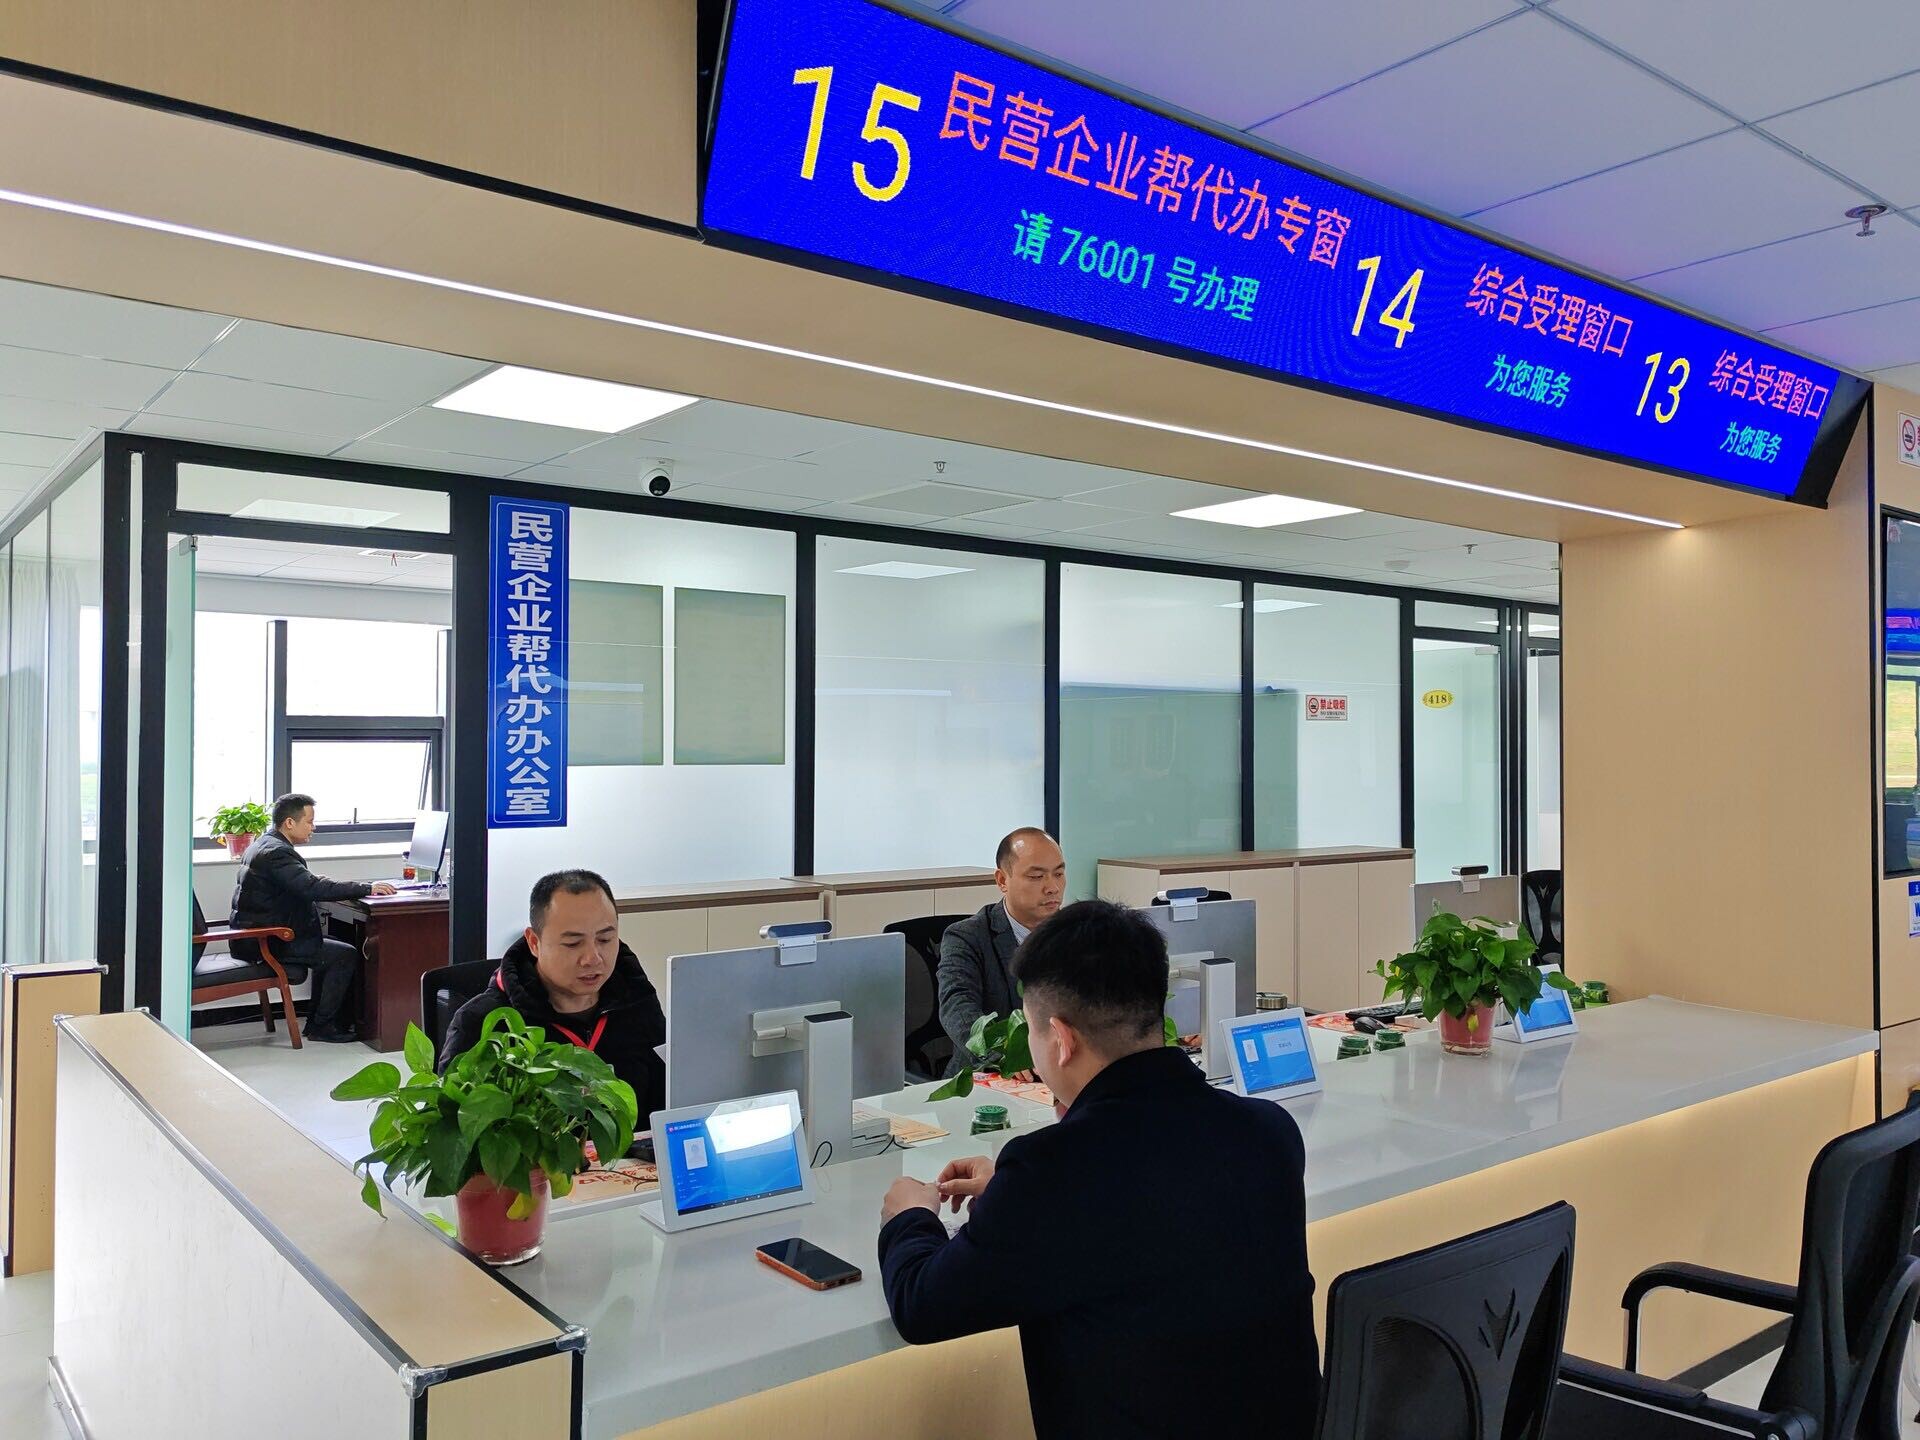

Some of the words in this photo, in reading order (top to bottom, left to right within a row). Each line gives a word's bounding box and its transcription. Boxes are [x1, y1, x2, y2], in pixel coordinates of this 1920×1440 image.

[792, 65, 921, 201] 15
[939, 71, 1352, 269] 民营企业帮代办专窗
[1013, 209, 1051, 264] 请
[1059, 227, 1155, 289] 76001
[1165, 256, 1261, 321] 号办理
[1351, 255, 1425, 349] 14
[1464, 262, 1634, 358] 综合受理窗口
[1485, 353, 1573, 409] 为您服务
[1636, 351, 1691, 424] 13
[1708, 349, 1830, 420] 综合受理窗口
[1720, 421, 1785, 464] 为您服务
[505, 511, 553, 817] 民营企业帮代办办公室
[1320, 699, 1346, 710] 禁止吸烟
[1428, 694, 1447, 704] 418
